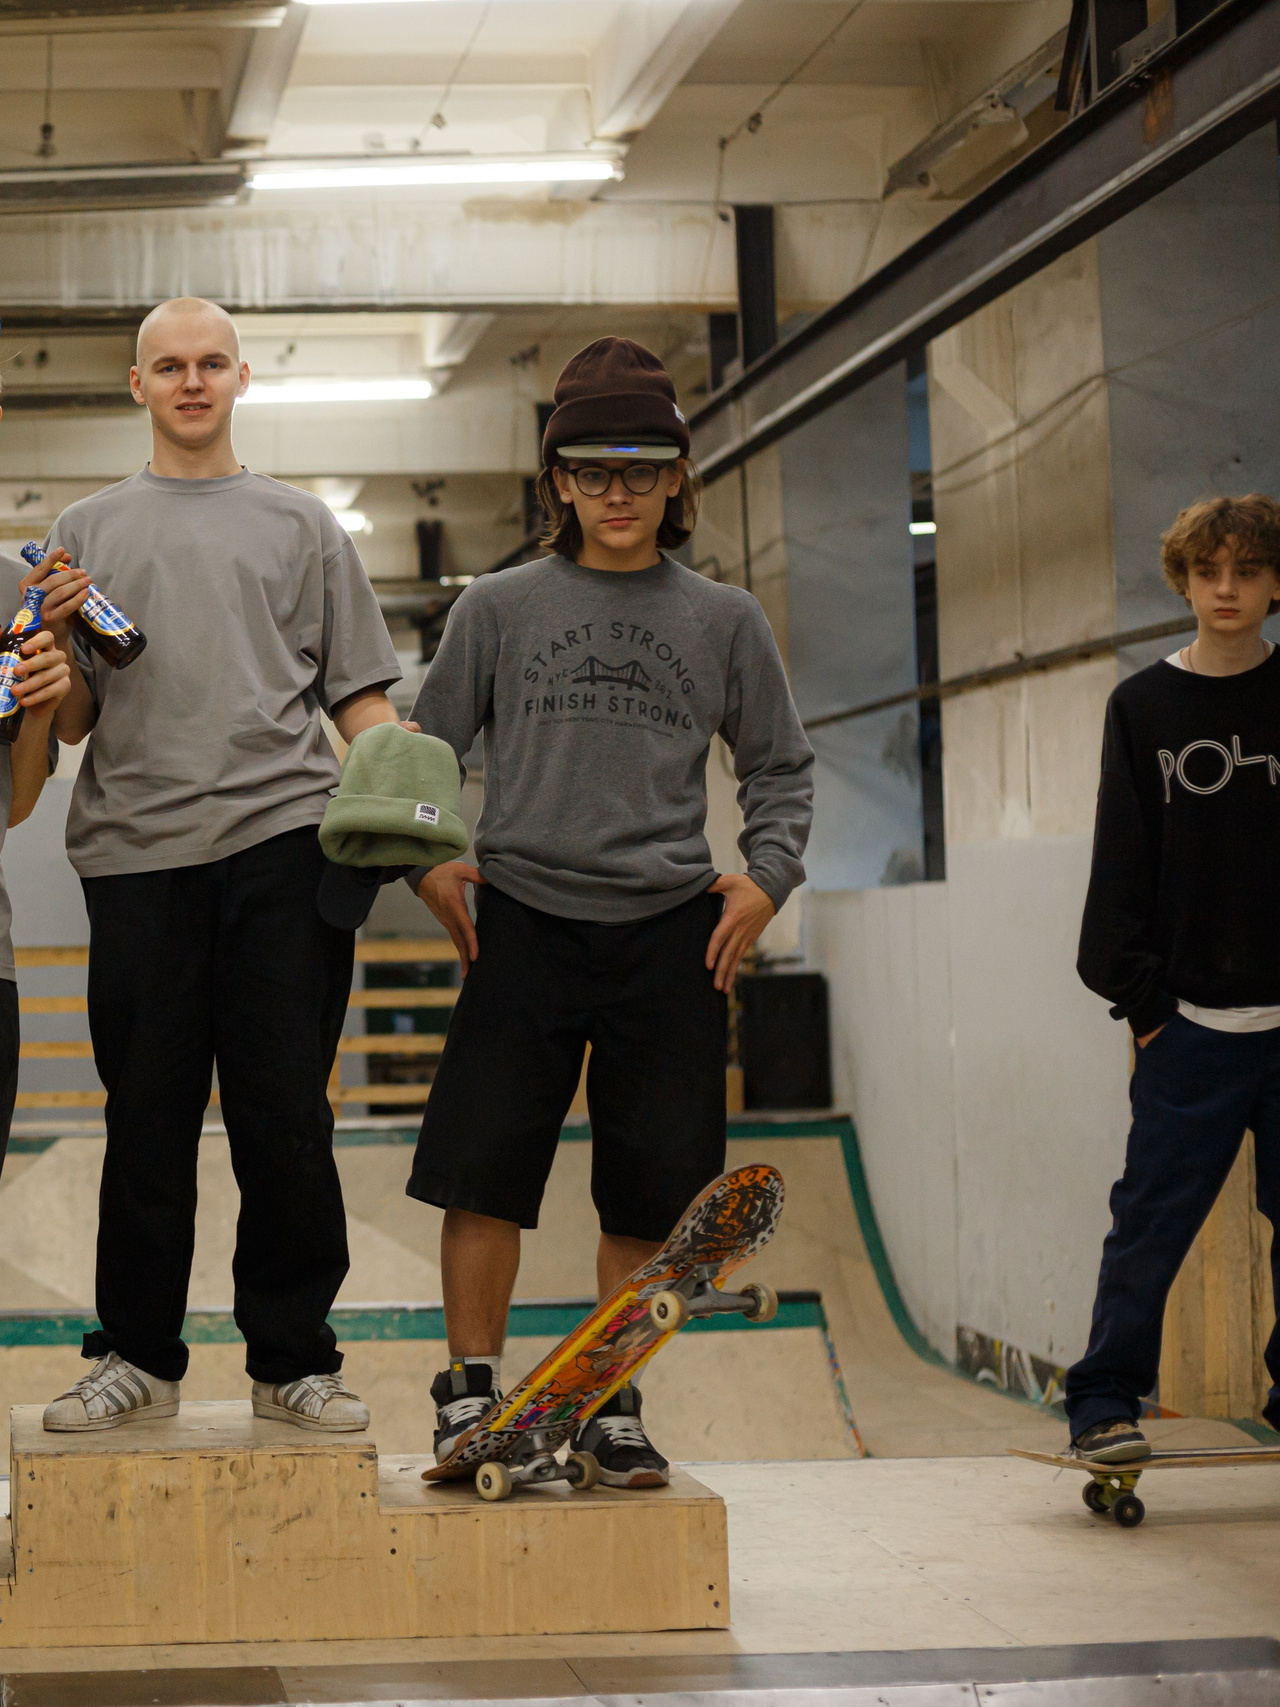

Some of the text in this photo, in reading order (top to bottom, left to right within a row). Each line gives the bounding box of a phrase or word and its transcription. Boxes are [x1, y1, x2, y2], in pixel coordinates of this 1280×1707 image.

[524, 621, 695, 695] START STRONG
[548, 668, 569, 687] NYC
[525, 692, 692, 730] FINISH STRONG
